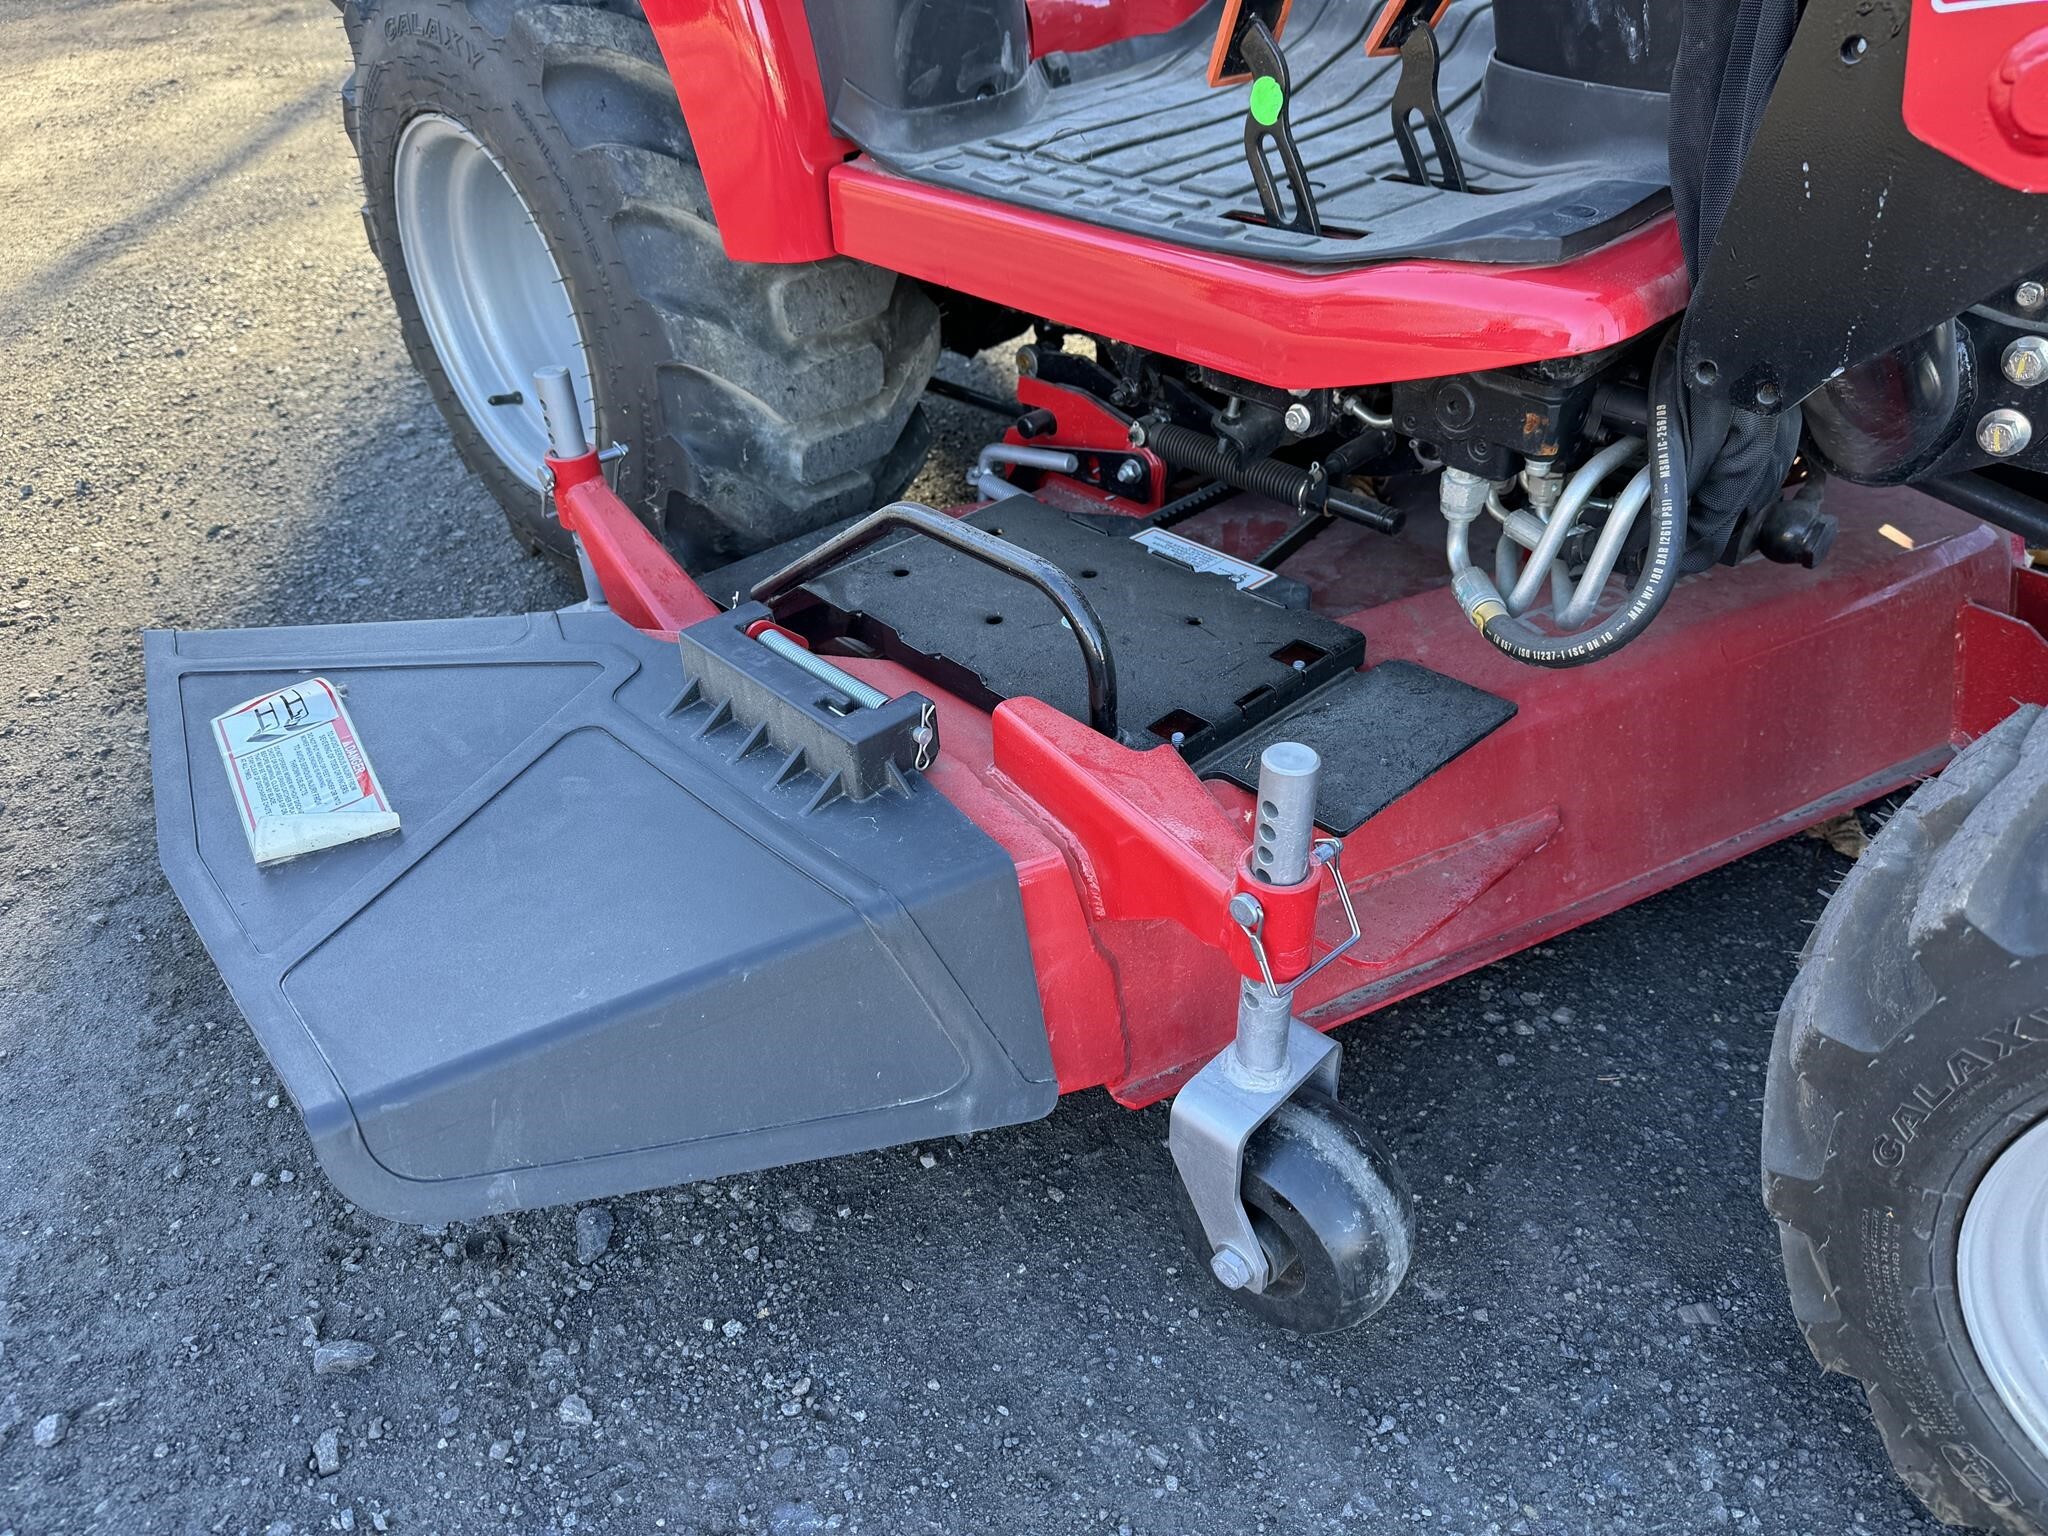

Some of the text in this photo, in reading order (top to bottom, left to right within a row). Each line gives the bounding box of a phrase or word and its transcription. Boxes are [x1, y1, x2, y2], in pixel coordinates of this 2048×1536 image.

[384, 10, 485, 70] GALAXY
[1656, 404, 1668, 451] IC-256/09
[1658, 452, 1671, 479] MSHA
[1655, 547, 1670, 566] BAR
[1649, 567, 1665, 584] 180
[1640, 585, 1656, 600] WP
[1627, 599, 1648, 620] MAX
[1586, 638, 1601, 652] DN
[1600, 631, 1614, 644] 10
[1518, 647, 1530, 659] ISO
[1532, 649, 1566, 661] 11237-1
[1568, 645, 1586, 658] 1SC
[343, 743, 366, 775] DANGER
